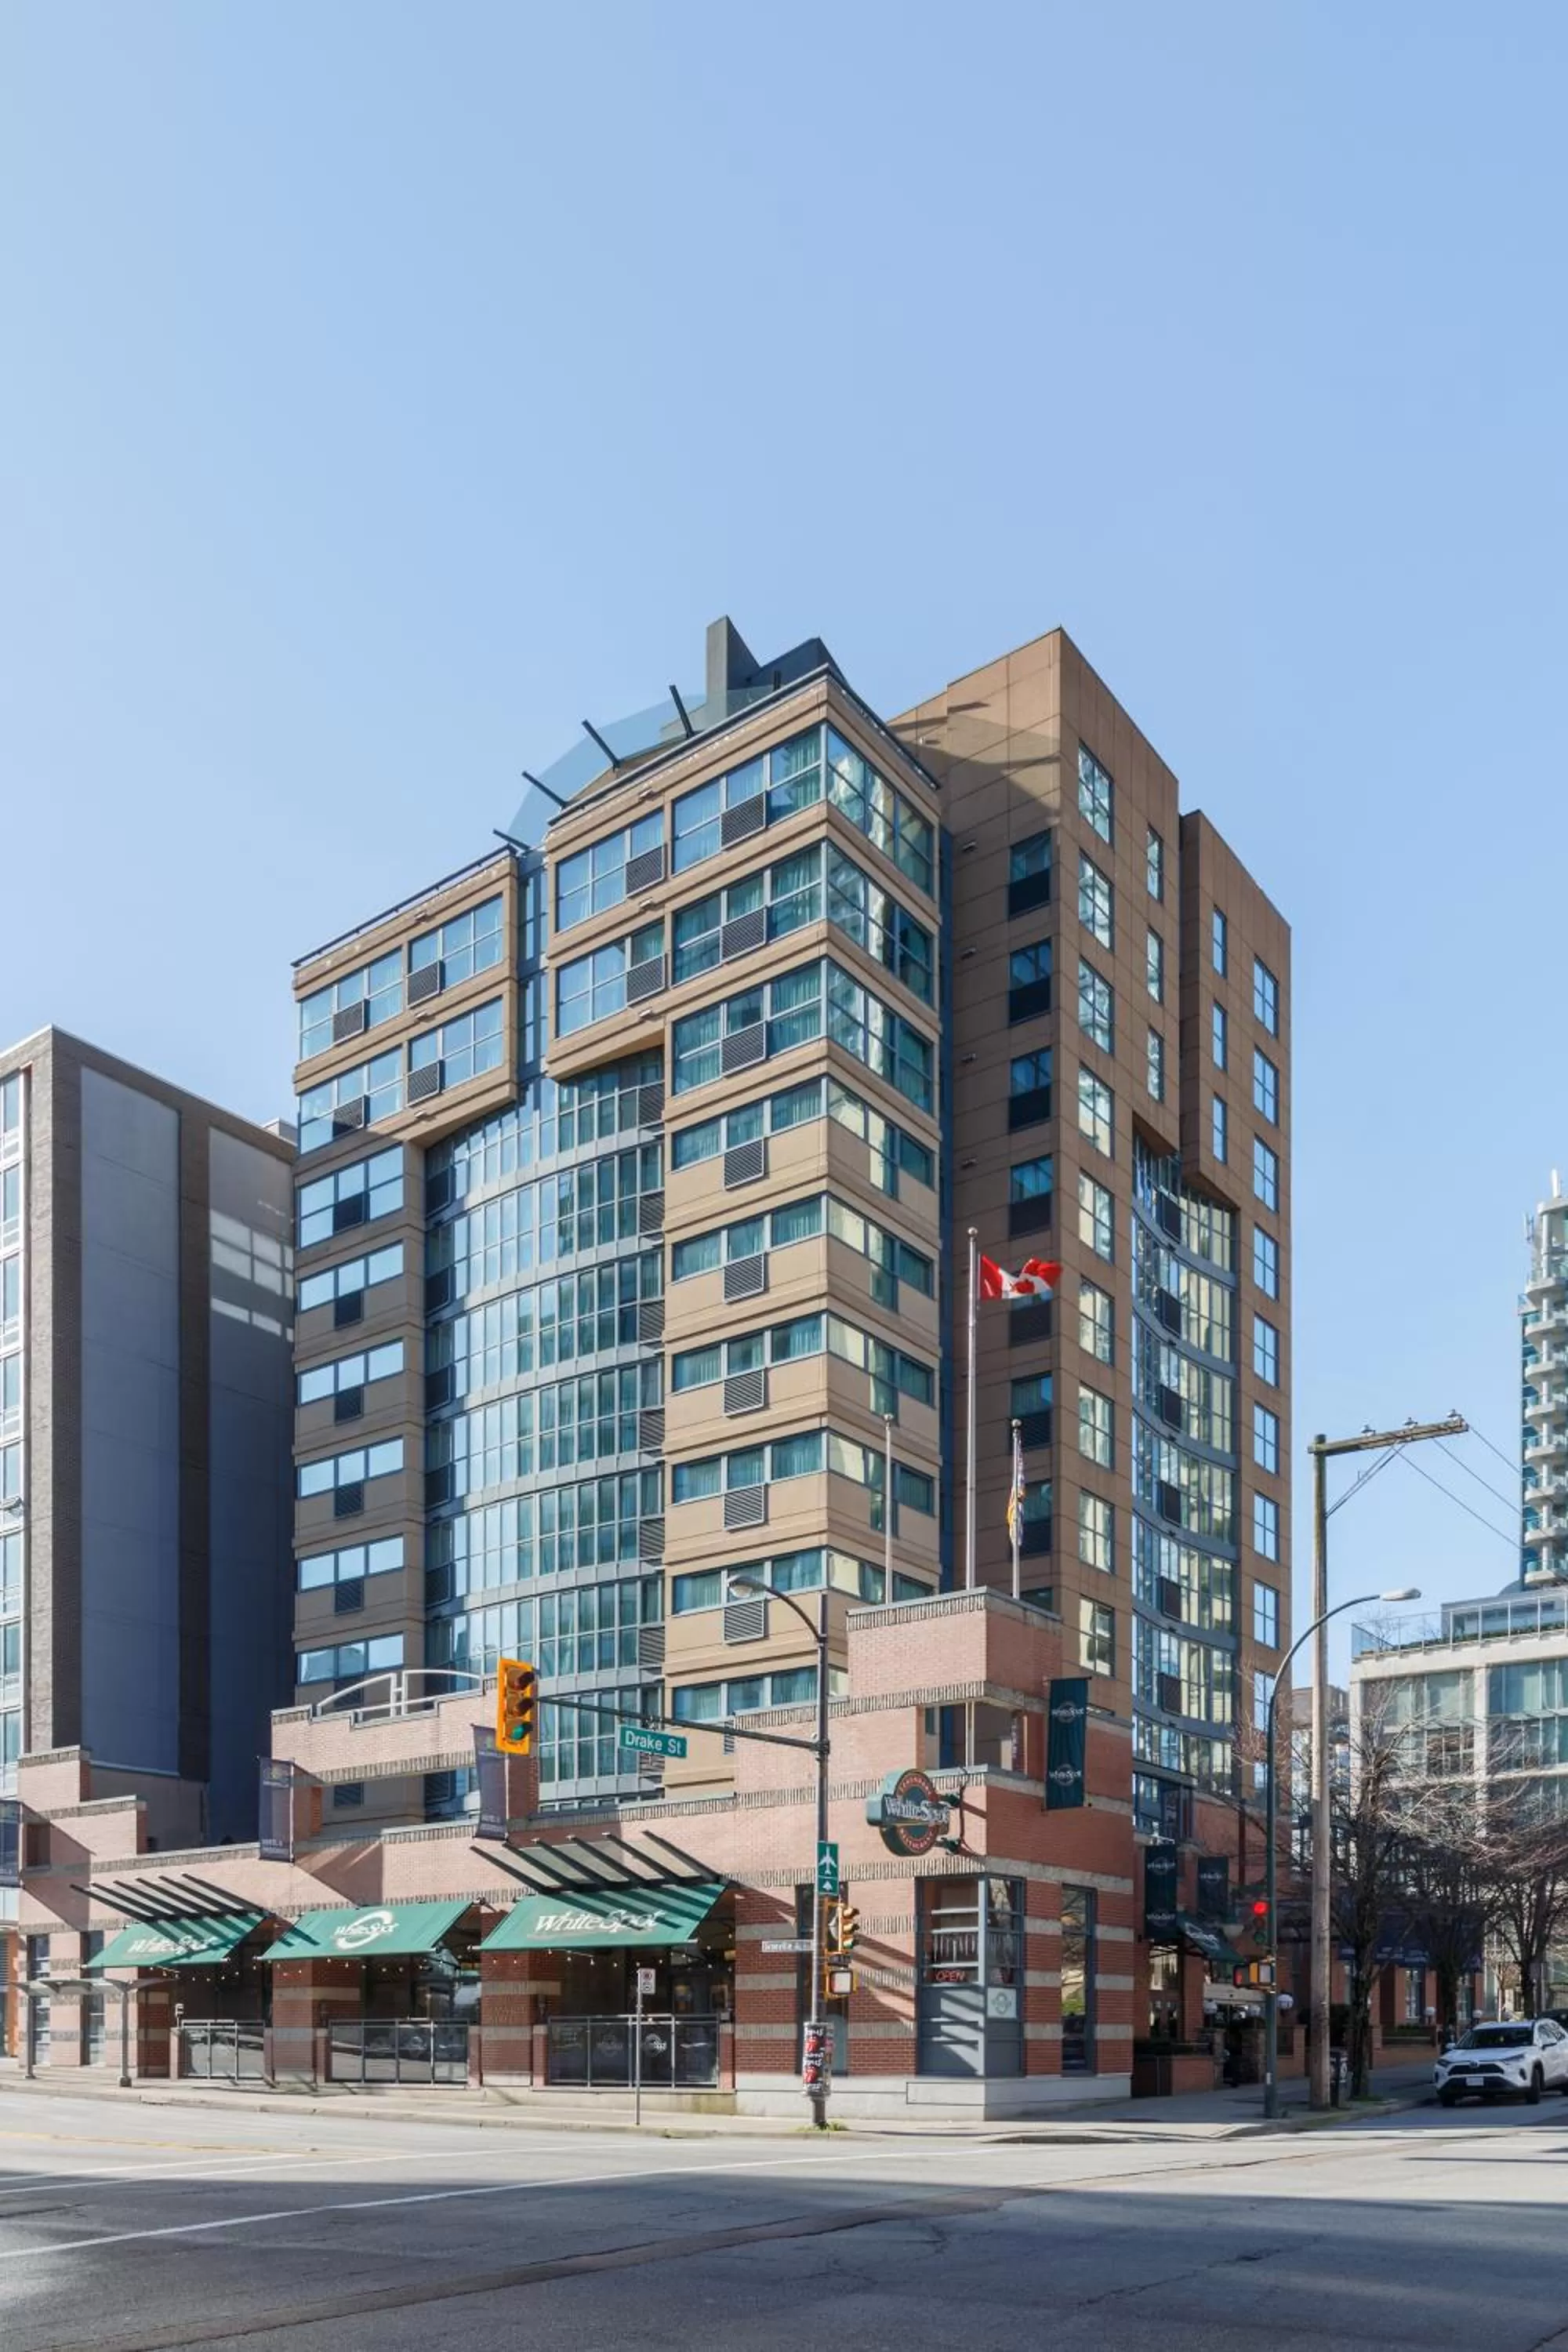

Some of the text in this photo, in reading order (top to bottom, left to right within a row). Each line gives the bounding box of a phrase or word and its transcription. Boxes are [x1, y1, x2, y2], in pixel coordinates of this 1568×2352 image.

[625, 1730, 682, 1755] Drake St
[935, 1969, 965, 1982] OPEN
